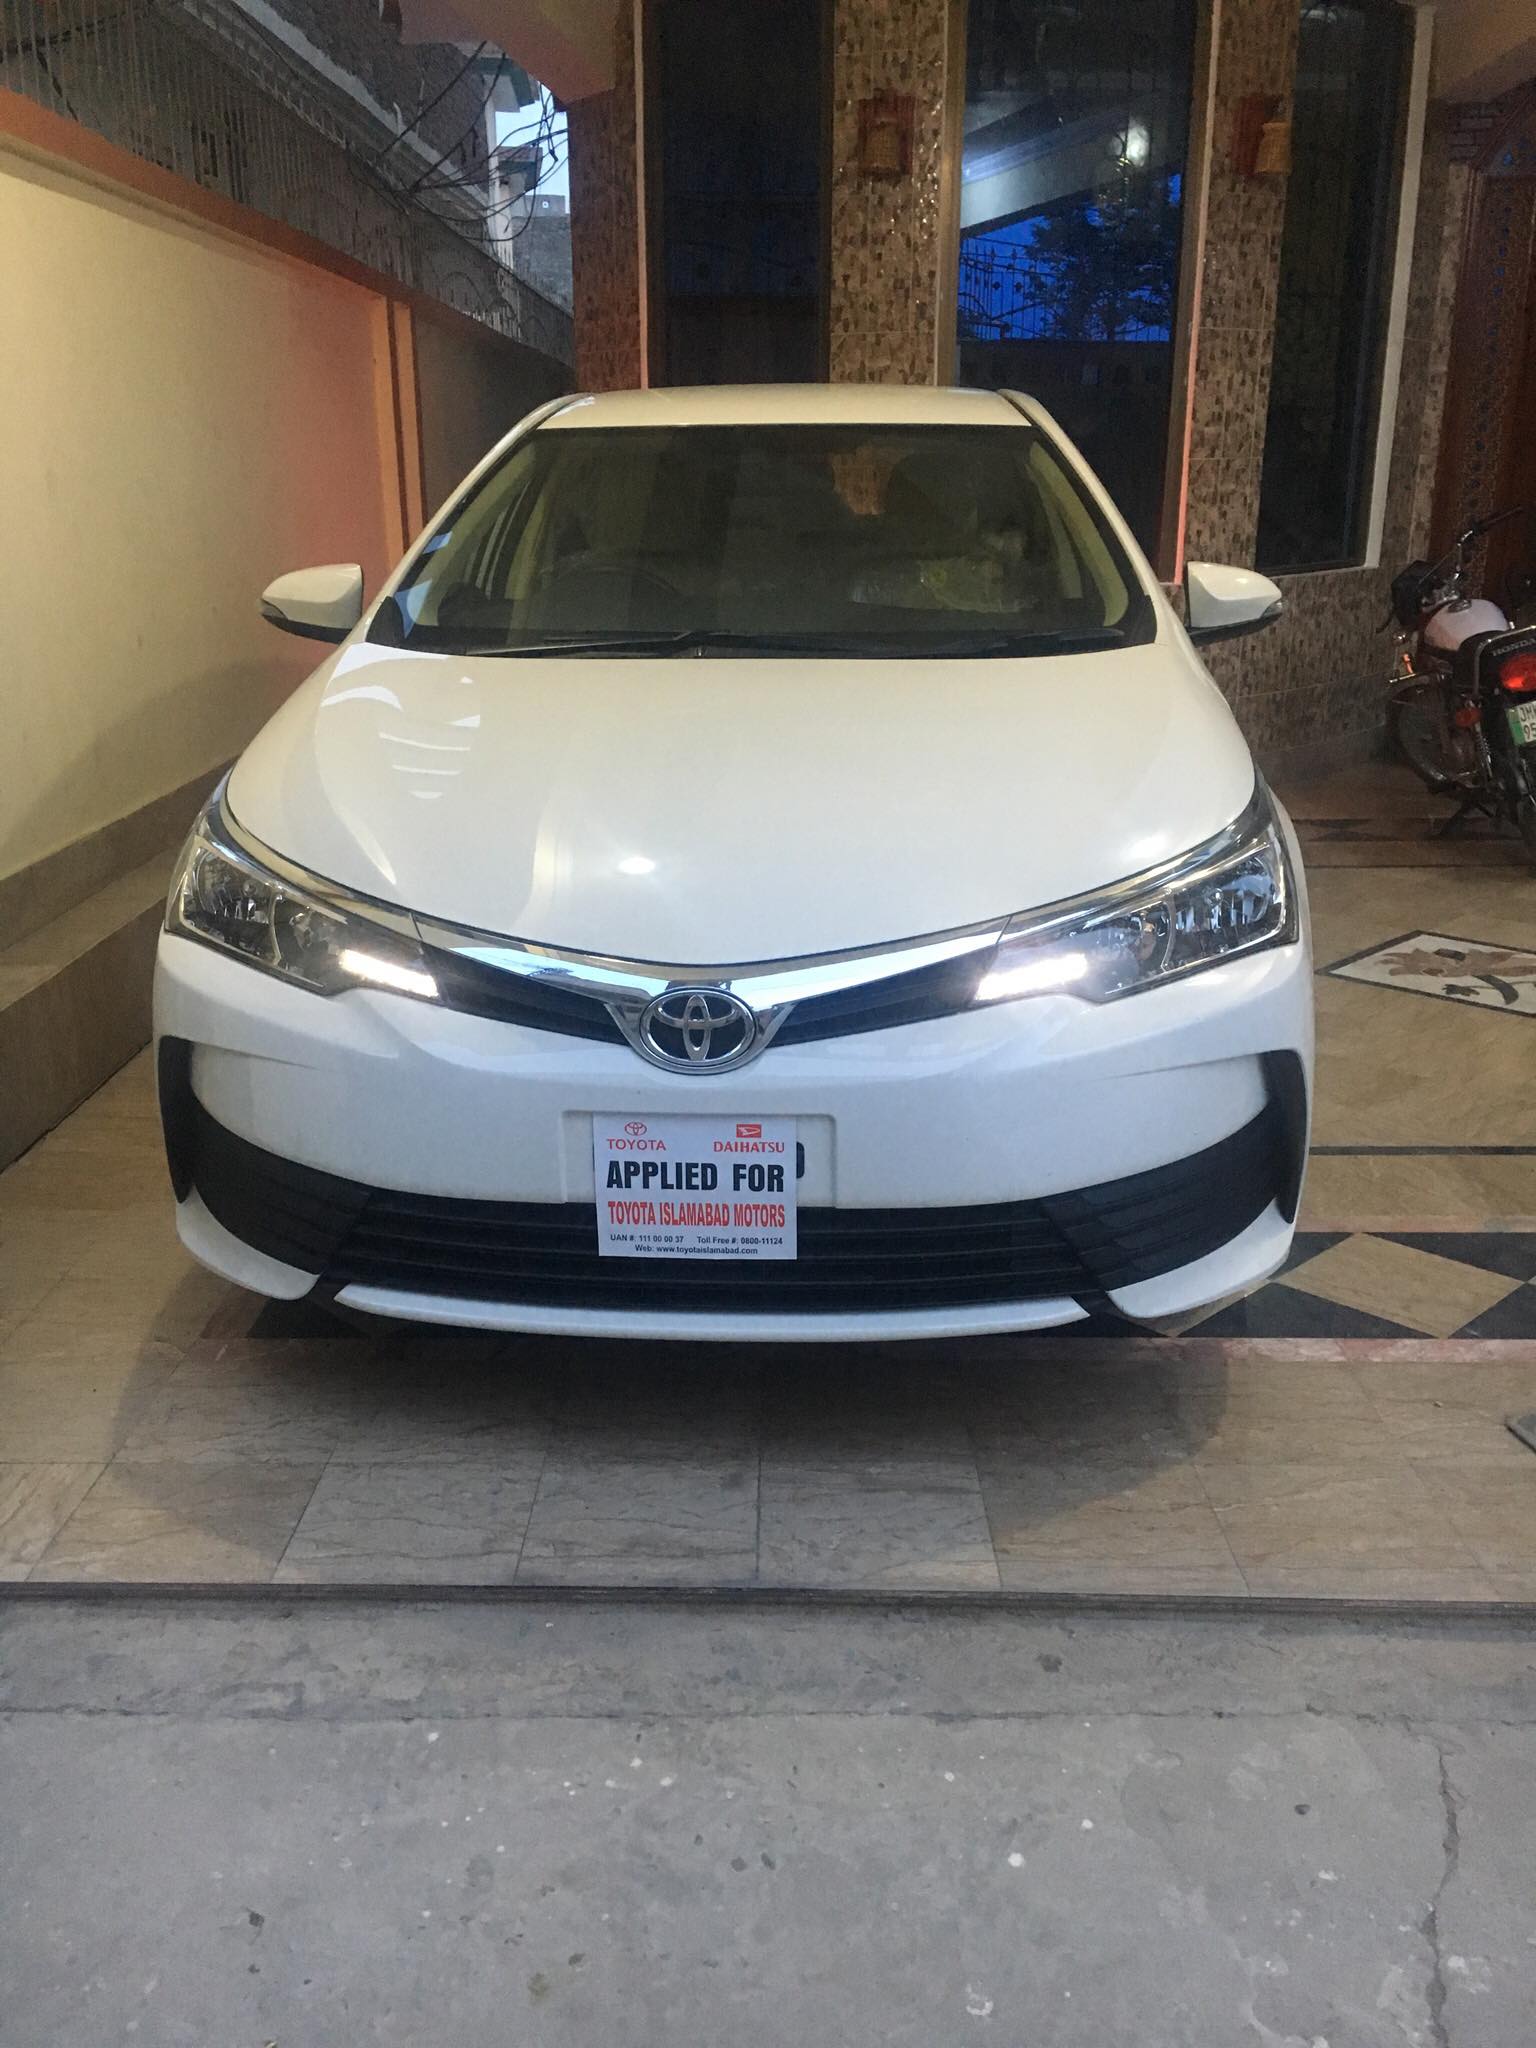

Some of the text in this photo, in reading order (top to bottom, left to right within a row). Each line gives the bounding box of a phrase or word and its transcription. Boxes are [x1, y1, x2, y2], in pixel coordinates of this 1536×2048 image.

[1519, 702, 1536, 721] JM
[606, 1138, 666, 1150] TOYOTA
[713, 1141, 785, 1153] DAIHATSU
[606, 1160, 784, 1192] APPLIED FOR
[608, 1201, 785, 1227] TOYOTA ISLAMABAD MOTORS
[697, 1236, 711, 1244] Toll
[712, 1236, 730, 1244] Free
[740, 1237, 783, 1245] 0800-11124
[635, 1244, 758, 1255] Web: www.toyotaislamabad.com
